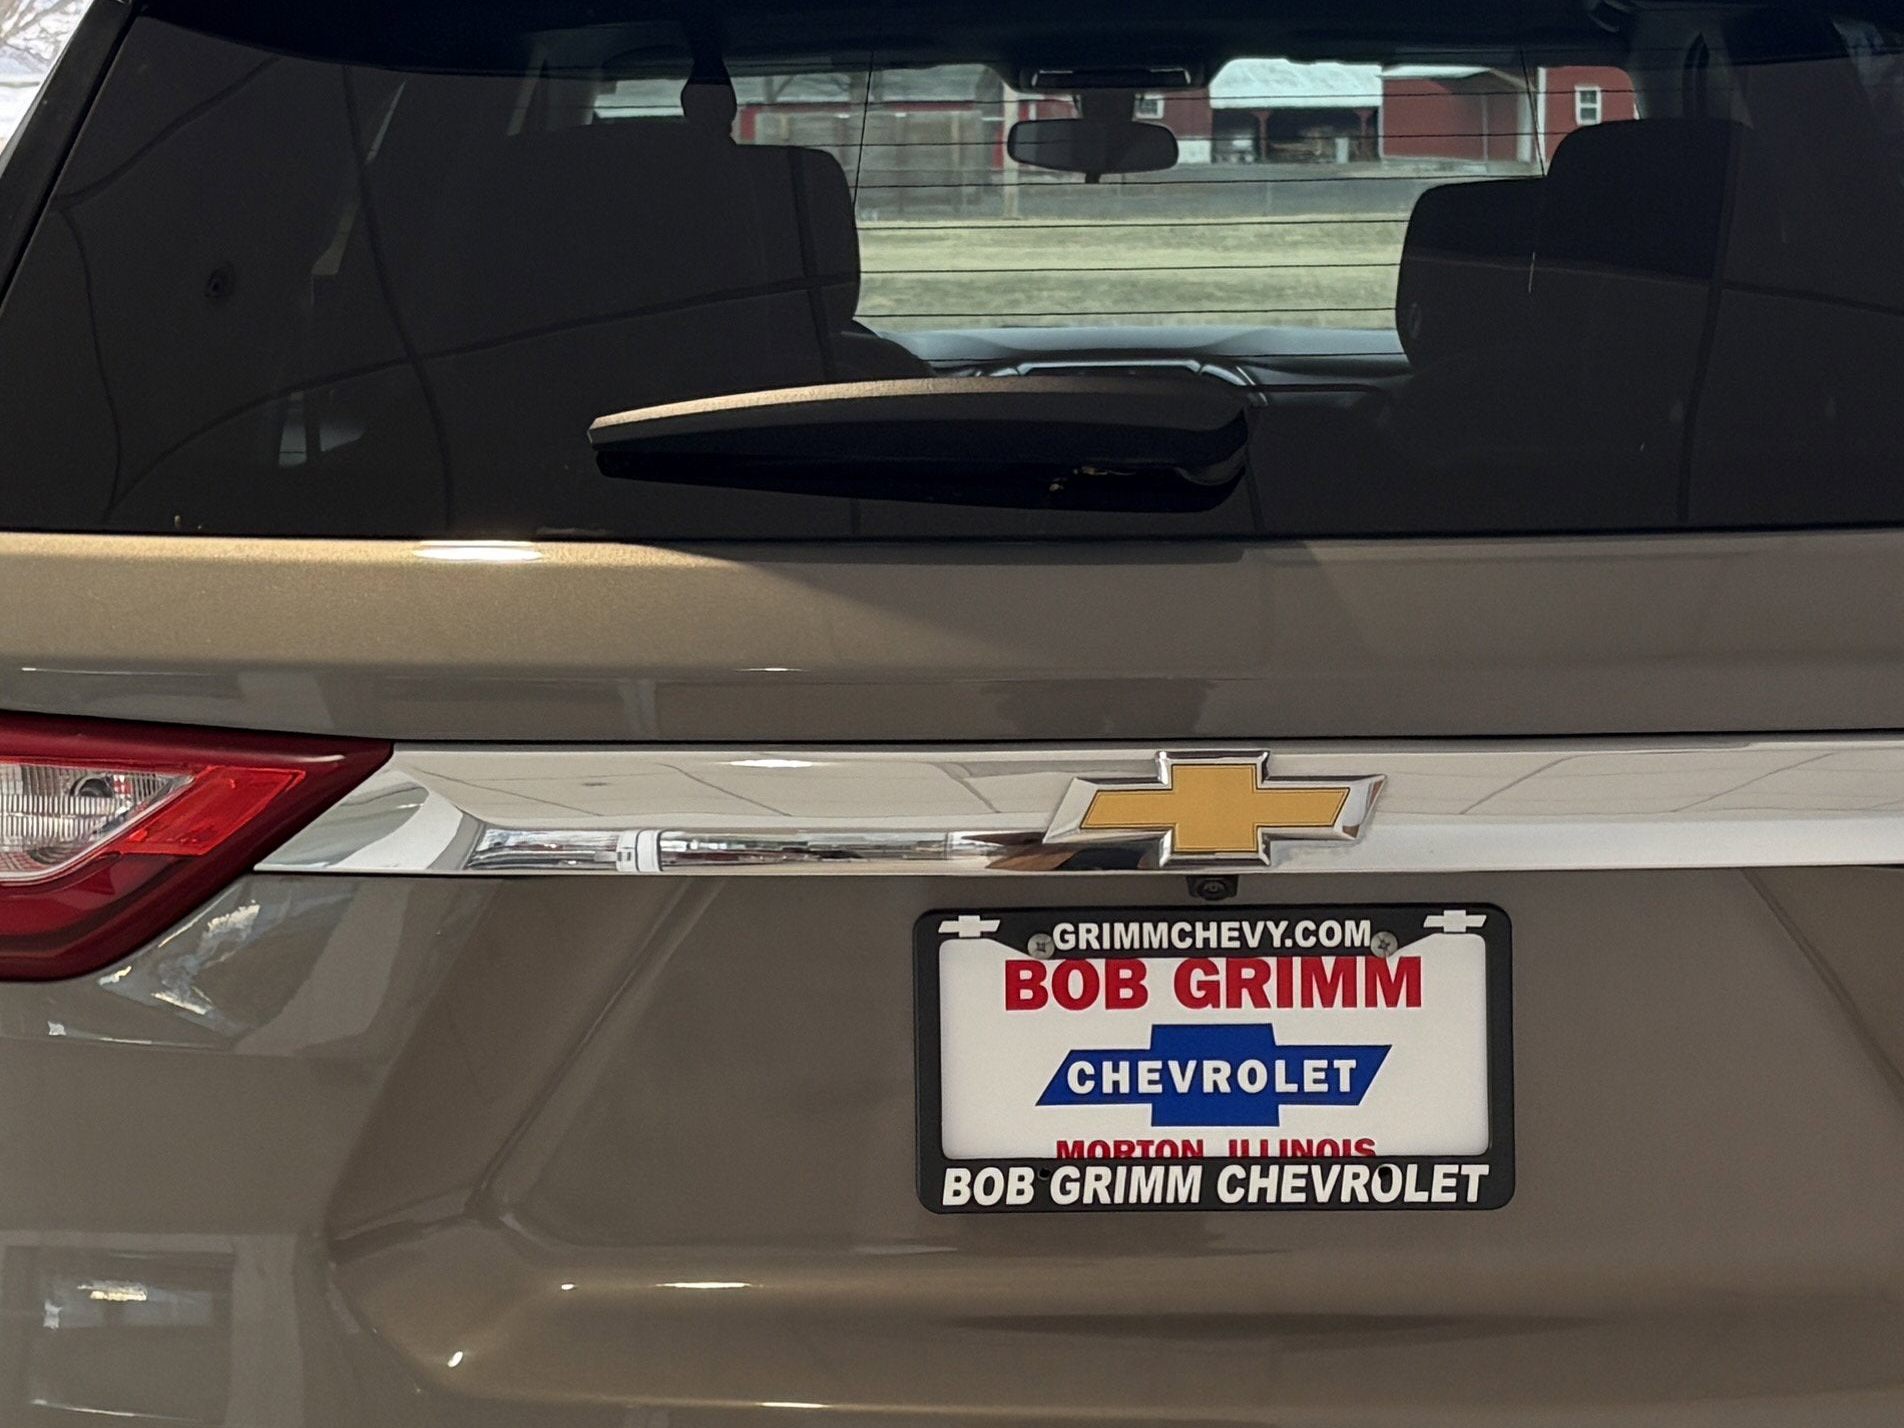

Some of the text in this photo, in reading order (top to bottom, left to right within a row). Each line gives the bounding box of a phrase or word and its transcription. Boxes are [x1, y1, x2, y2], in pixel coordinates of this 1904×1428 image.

[1052, 919, 1372, 951] GRIMMCHEVY.COM
[1004, 956, 1422, 1011] BOB GRIMM
[1066, 1058, 1357, 1095] CHEVROLET
[942, 1163, 1490, 1206] BOB GRIMM CHEVROLET
